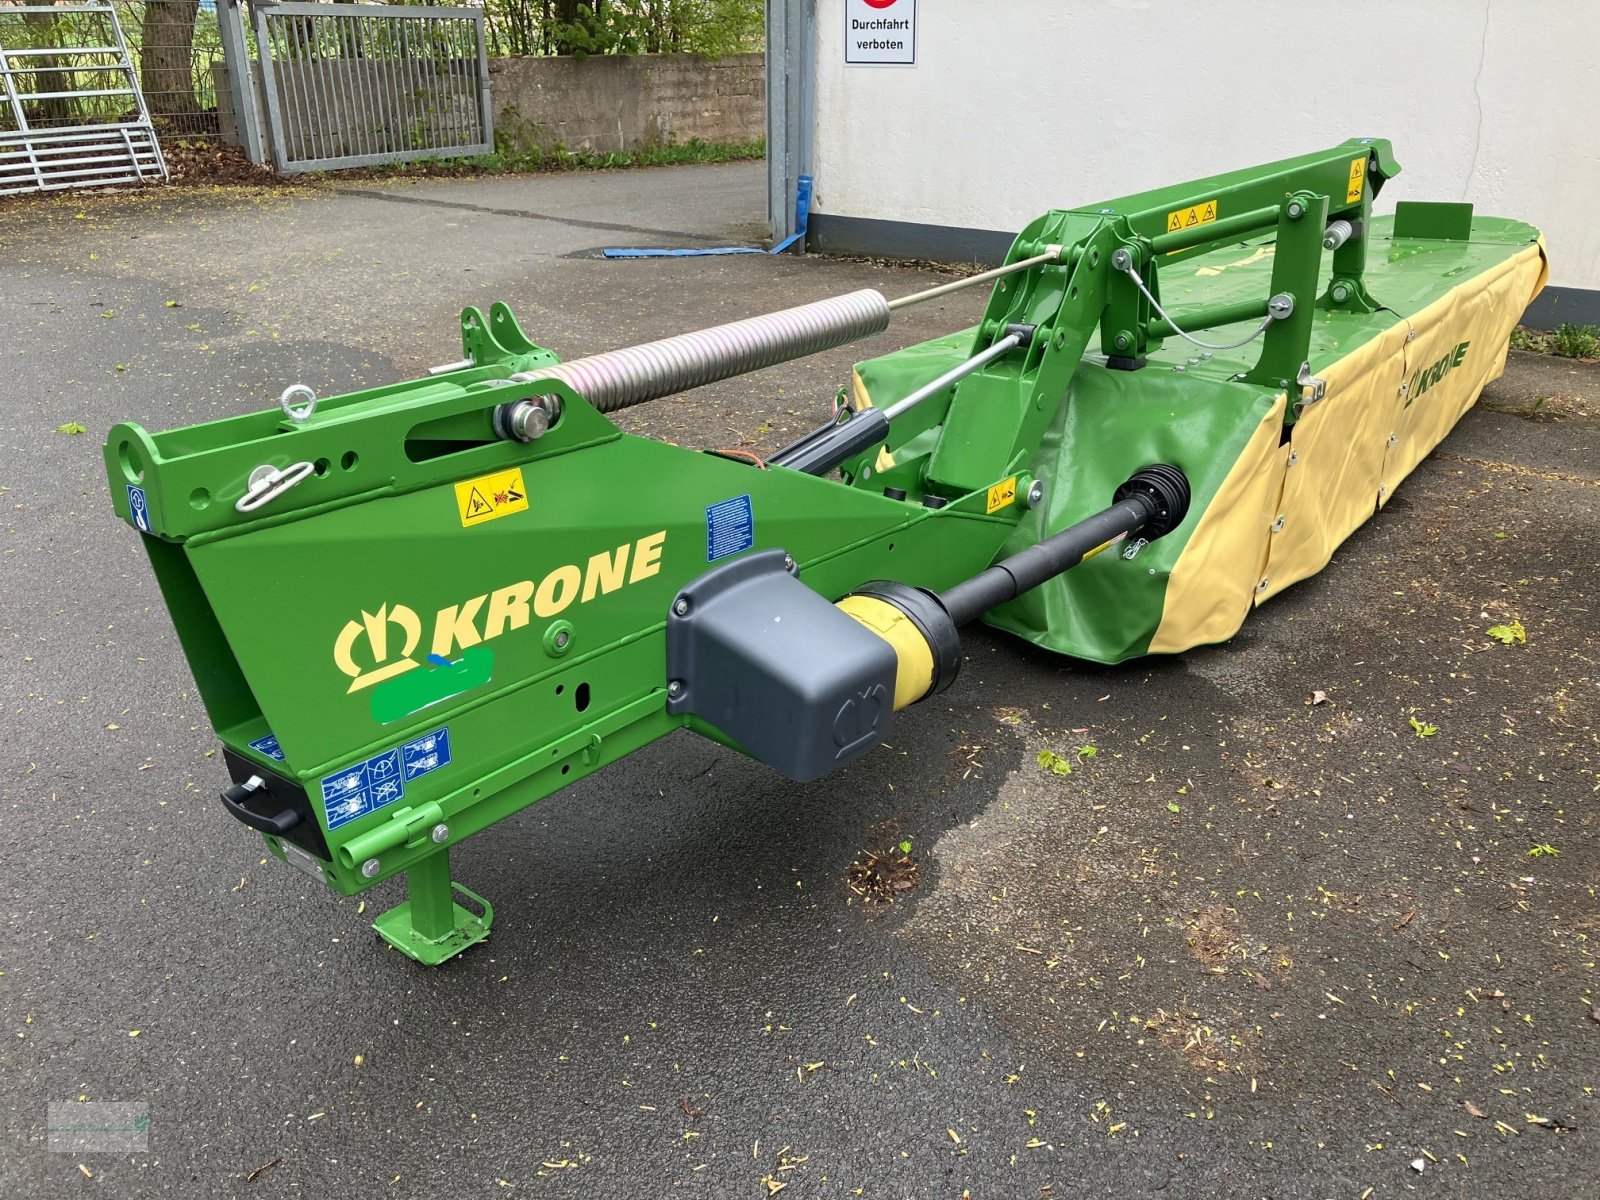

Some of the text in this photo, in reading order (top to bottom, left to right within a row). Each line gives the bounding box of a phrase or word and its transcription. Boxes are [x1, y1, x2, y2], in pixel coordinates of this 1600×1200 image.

[852, 18, 909, 30] Durchfahrt
[857, 38, 904, 50] verboten
[430, 529, 667, 657] KRONE
